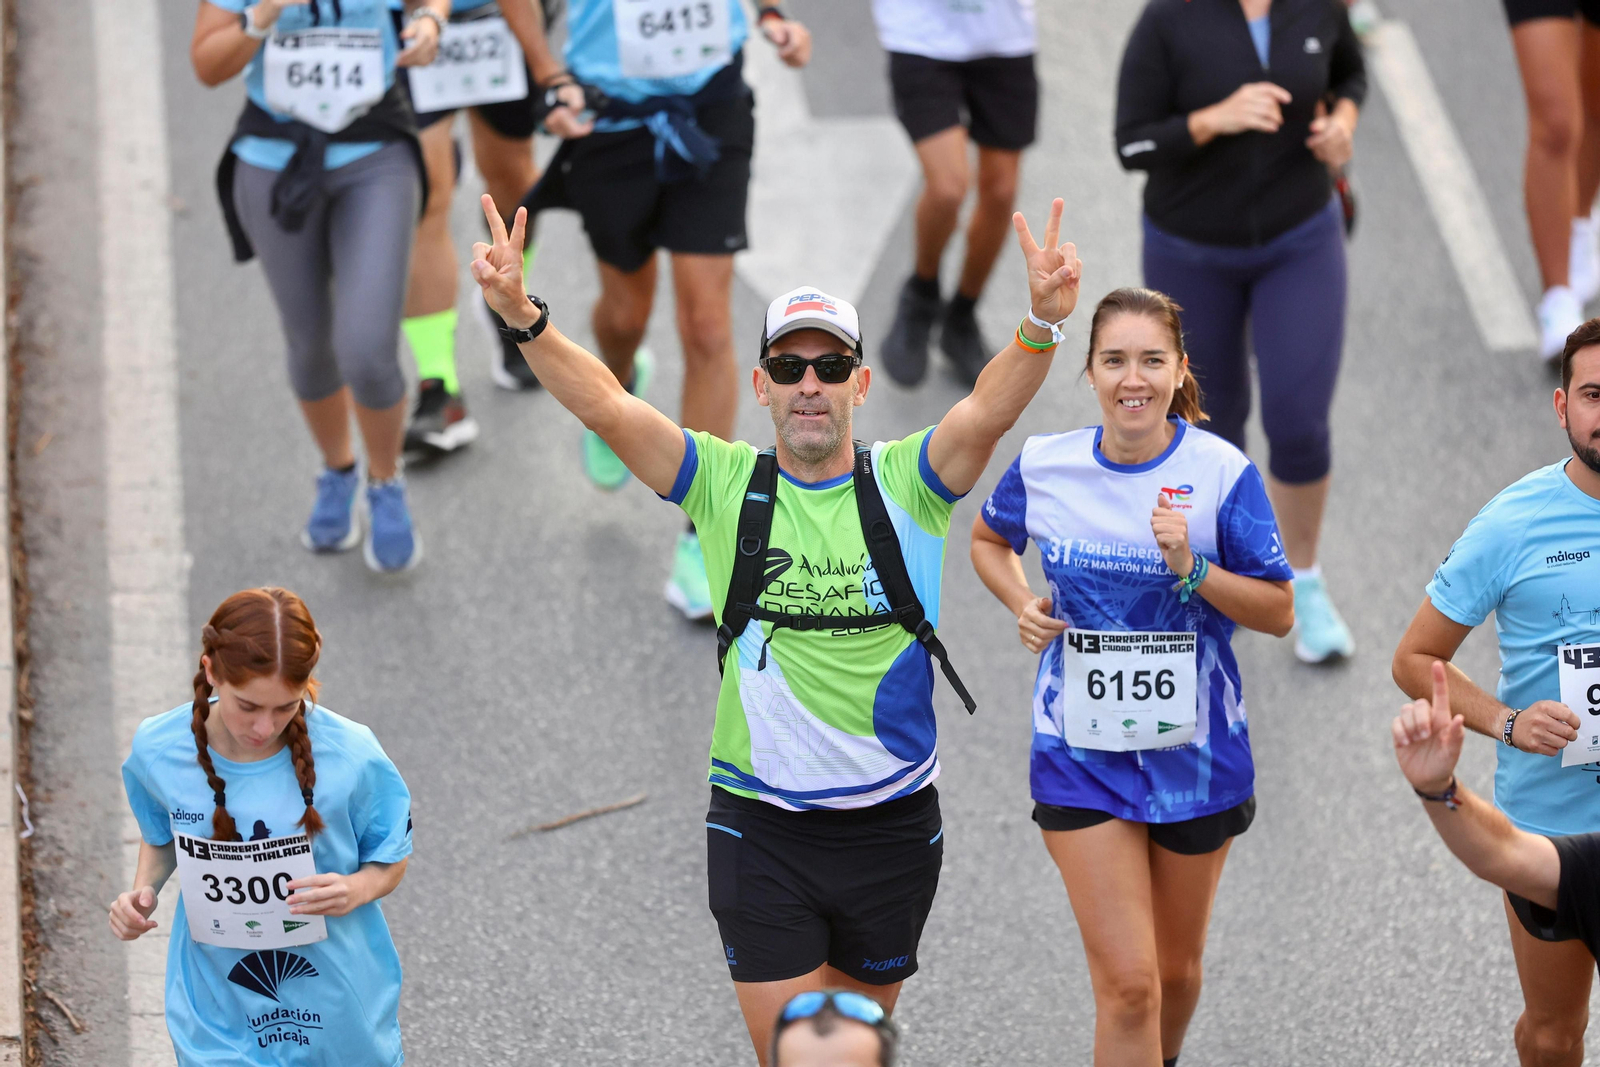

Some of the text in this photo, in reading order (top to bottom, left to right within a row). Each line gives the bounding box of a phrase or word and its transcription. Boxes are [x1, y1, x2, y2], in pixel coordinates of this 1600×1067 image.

[638, 2, 714, 39] 6413
[286, 61, 364, 89] 6414
[788, 293, 836, 305] PEPSI
[1047, 536, 1163, 565] 31 TotalEnerg
[798, 552, 874, 578] Andalucía
[1074, 558, 1088, 568] 1/2
[1091, 558, 1140, 573] MARATÓN
[765, 577, 886, 602] DESAFÍO
[1068, 632, 1195, 654] 43 CARRERA URBANA
[1102, 644, 1132, 652] CIUDAD
[1087, 669, 1176, 701] 6156
[178, 834, 309, 861] 43 CARRERA URBANA
[212, 852, 243, 861] CIUDAD
[202, 872, 296, 905] 3300
[246, 1007, 321, 1027] undación
[257, 1026, 311, 1048] Unicaja
